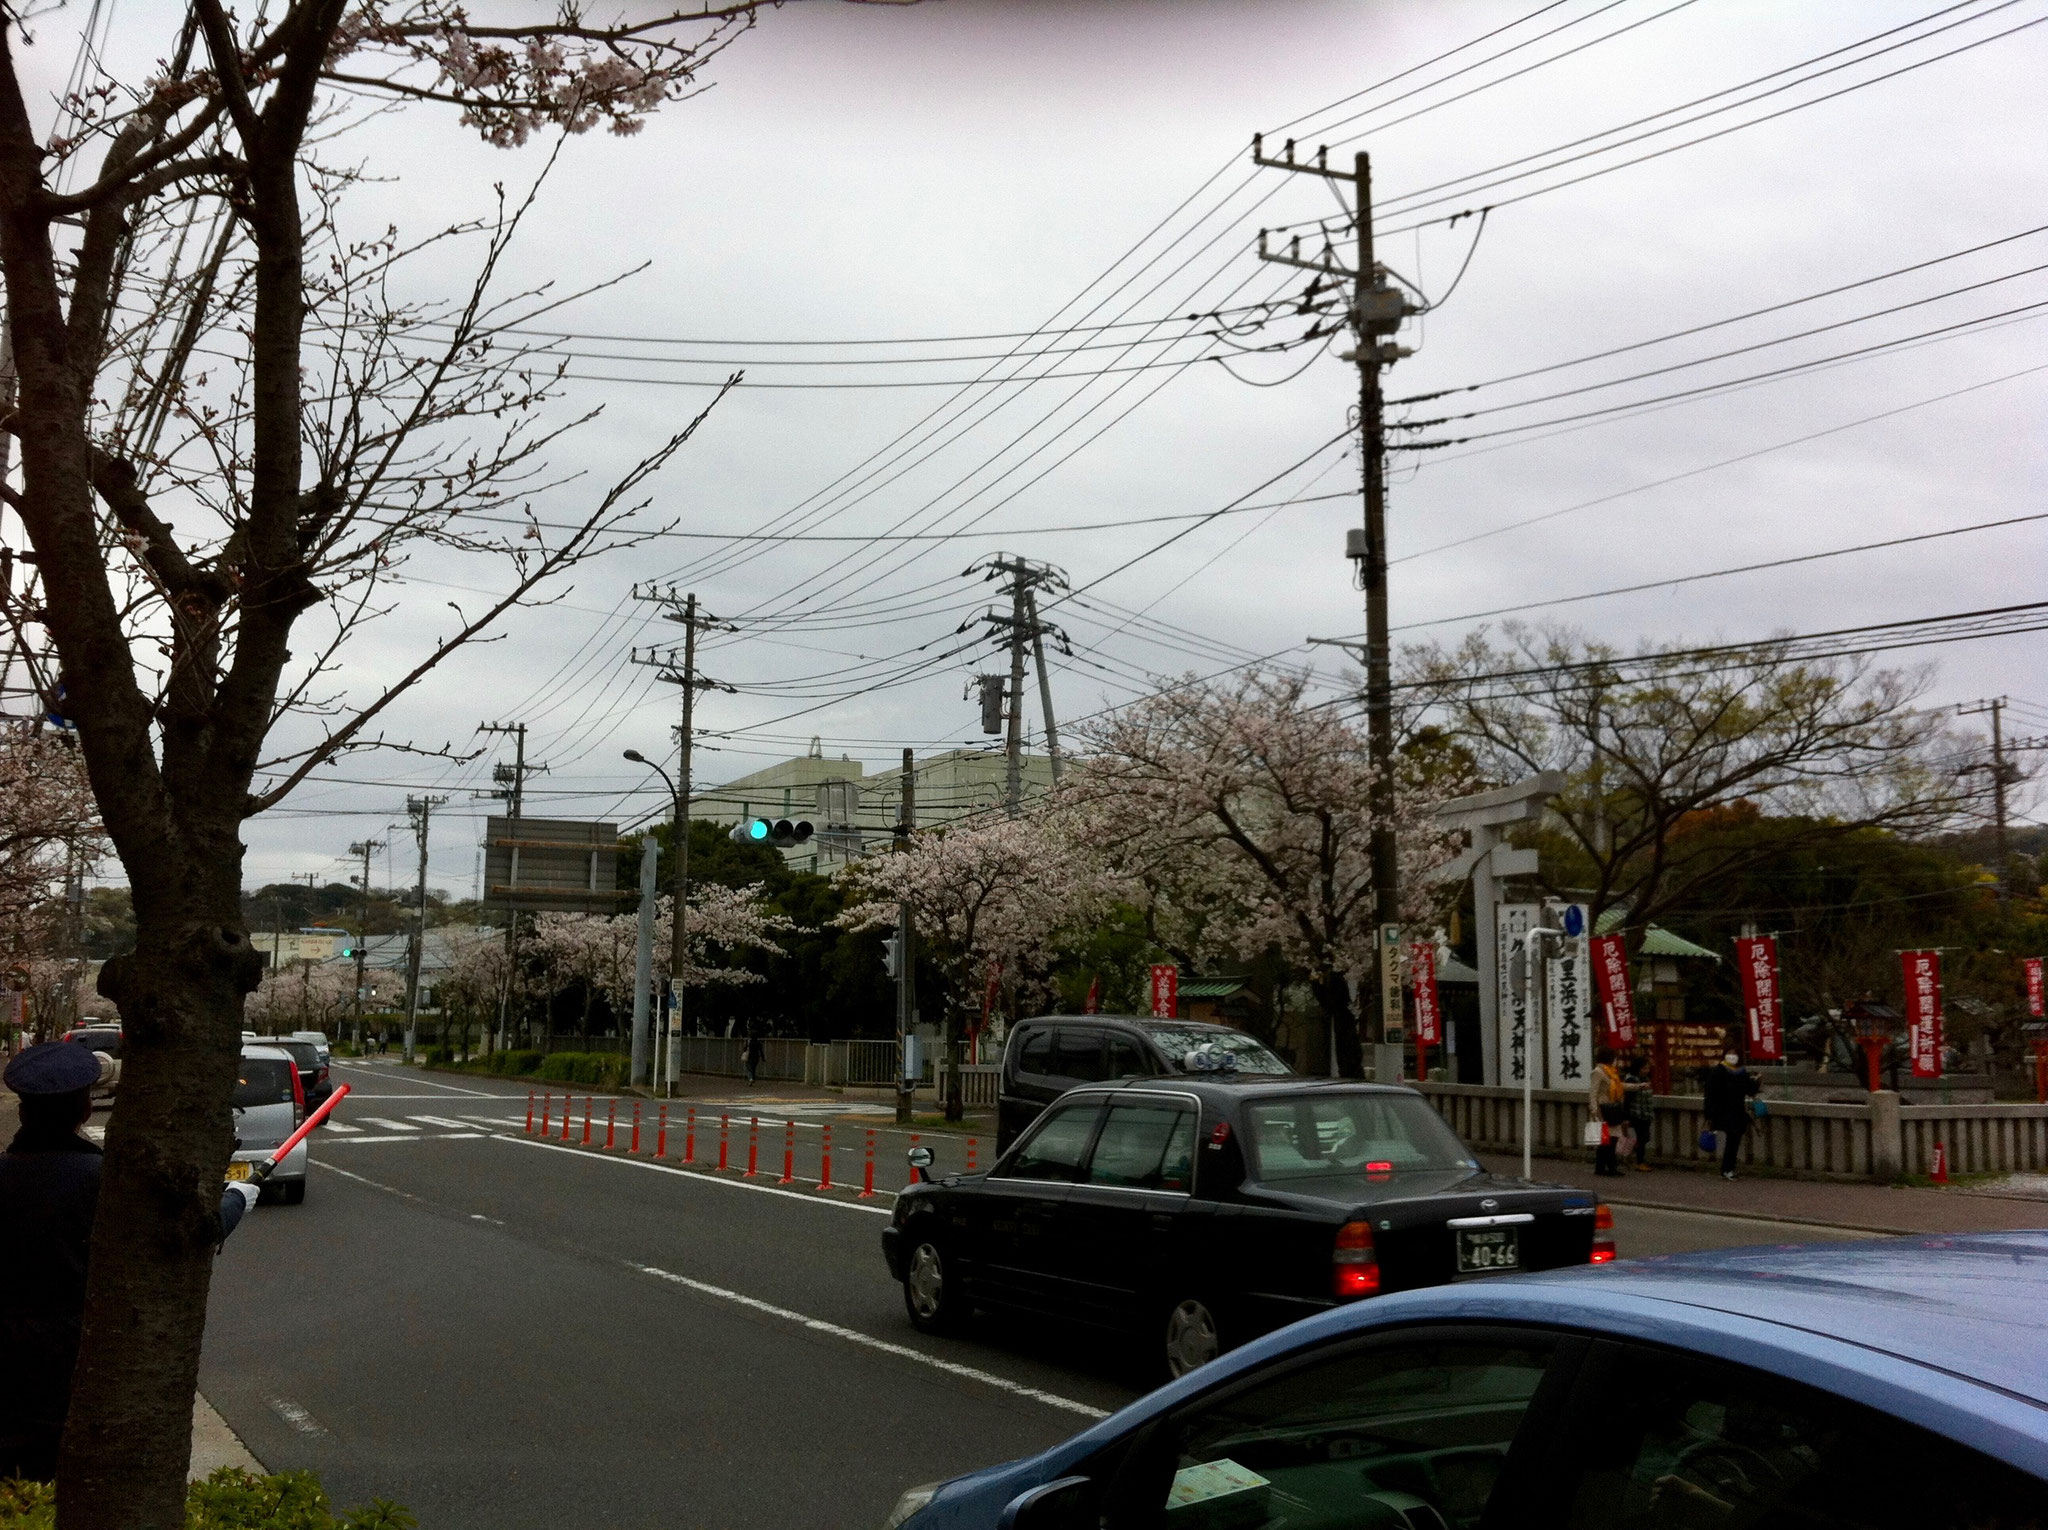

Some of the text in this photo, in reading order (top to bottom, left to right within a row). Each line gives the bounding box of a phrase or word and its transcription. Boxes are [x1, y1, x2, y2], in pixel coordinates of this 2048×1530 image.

[1559, 940, 1582, 1080] 里浜天神社
[1472, 1244, 1515, 1267] 40-66
